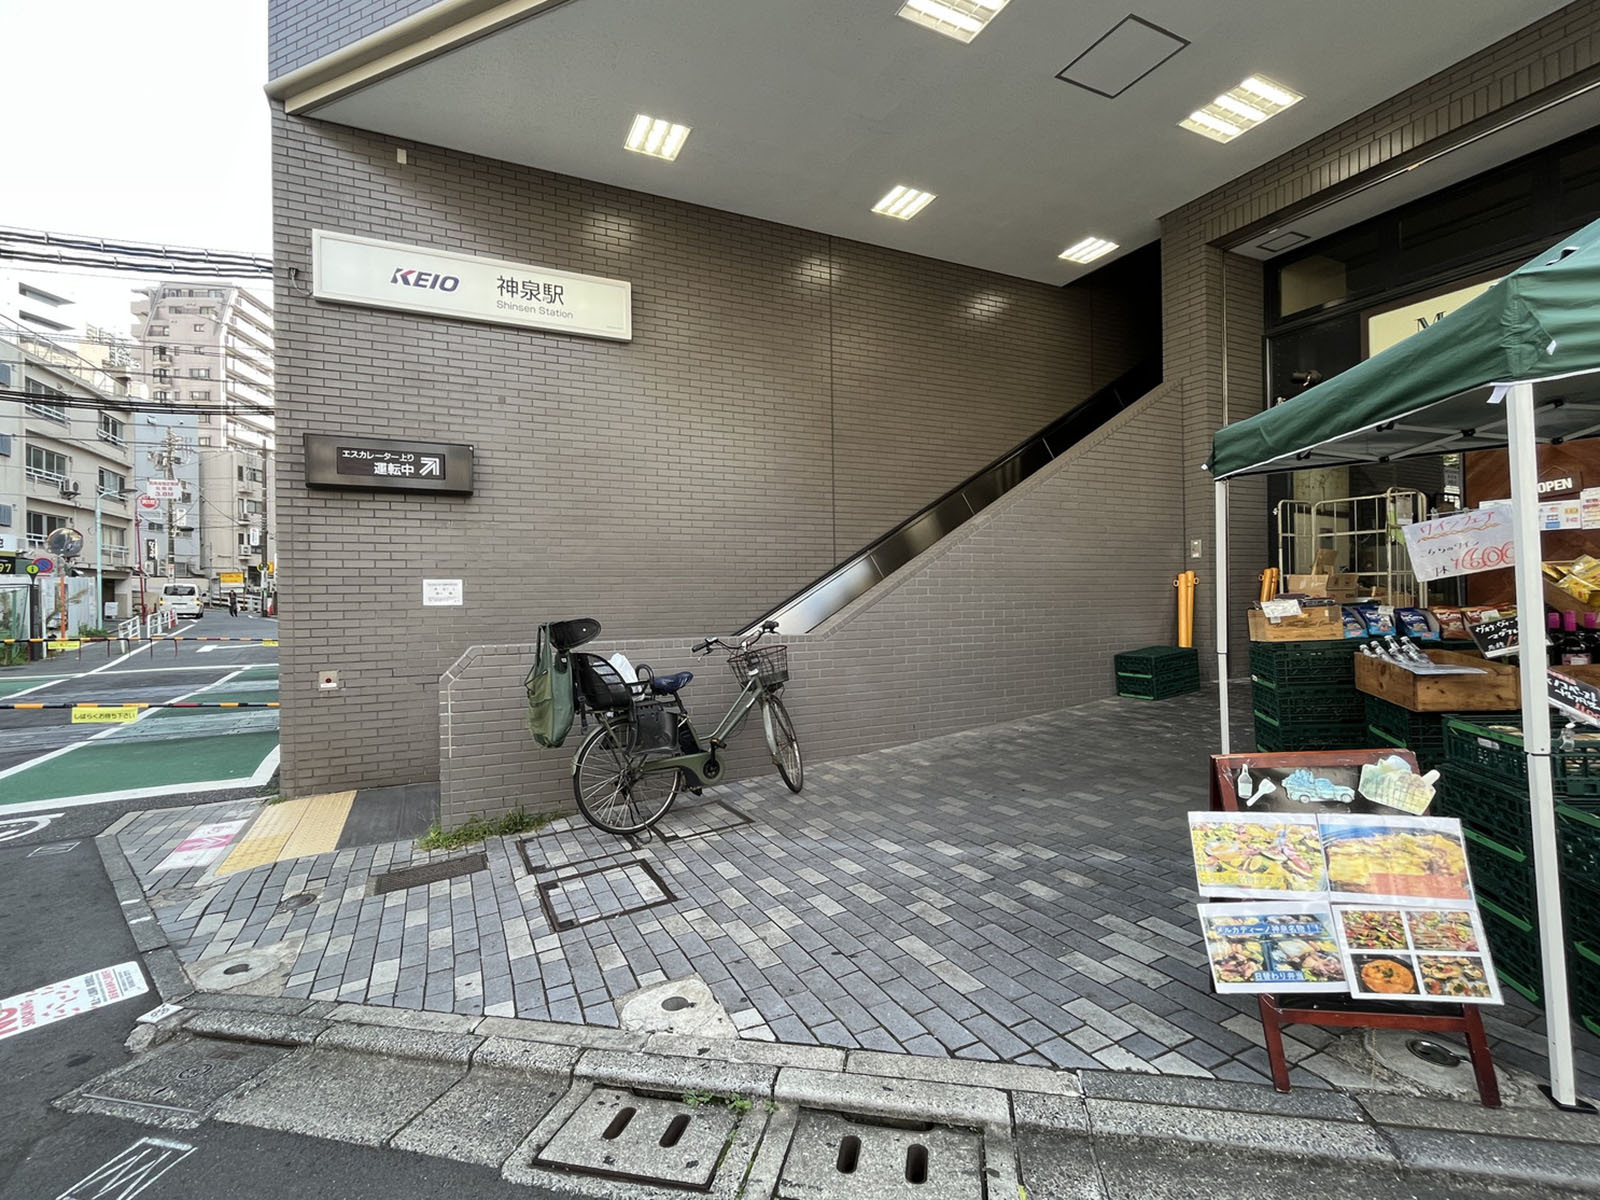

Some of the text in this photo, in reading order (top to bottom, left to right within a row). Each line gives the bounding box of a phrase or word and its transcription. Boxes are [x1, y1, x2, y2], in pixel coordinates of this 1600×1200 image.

[390, 268, 460, 292] KEIO
[496, 274, 564, 305] 神泉駅
[496, 300, 574, 319] Shinsen Station
[342, 450, 415, 462] エスカレーター上り
[373, 462, 415, 476] 運転中
[1537, 477, 1573, 493] OPEN
